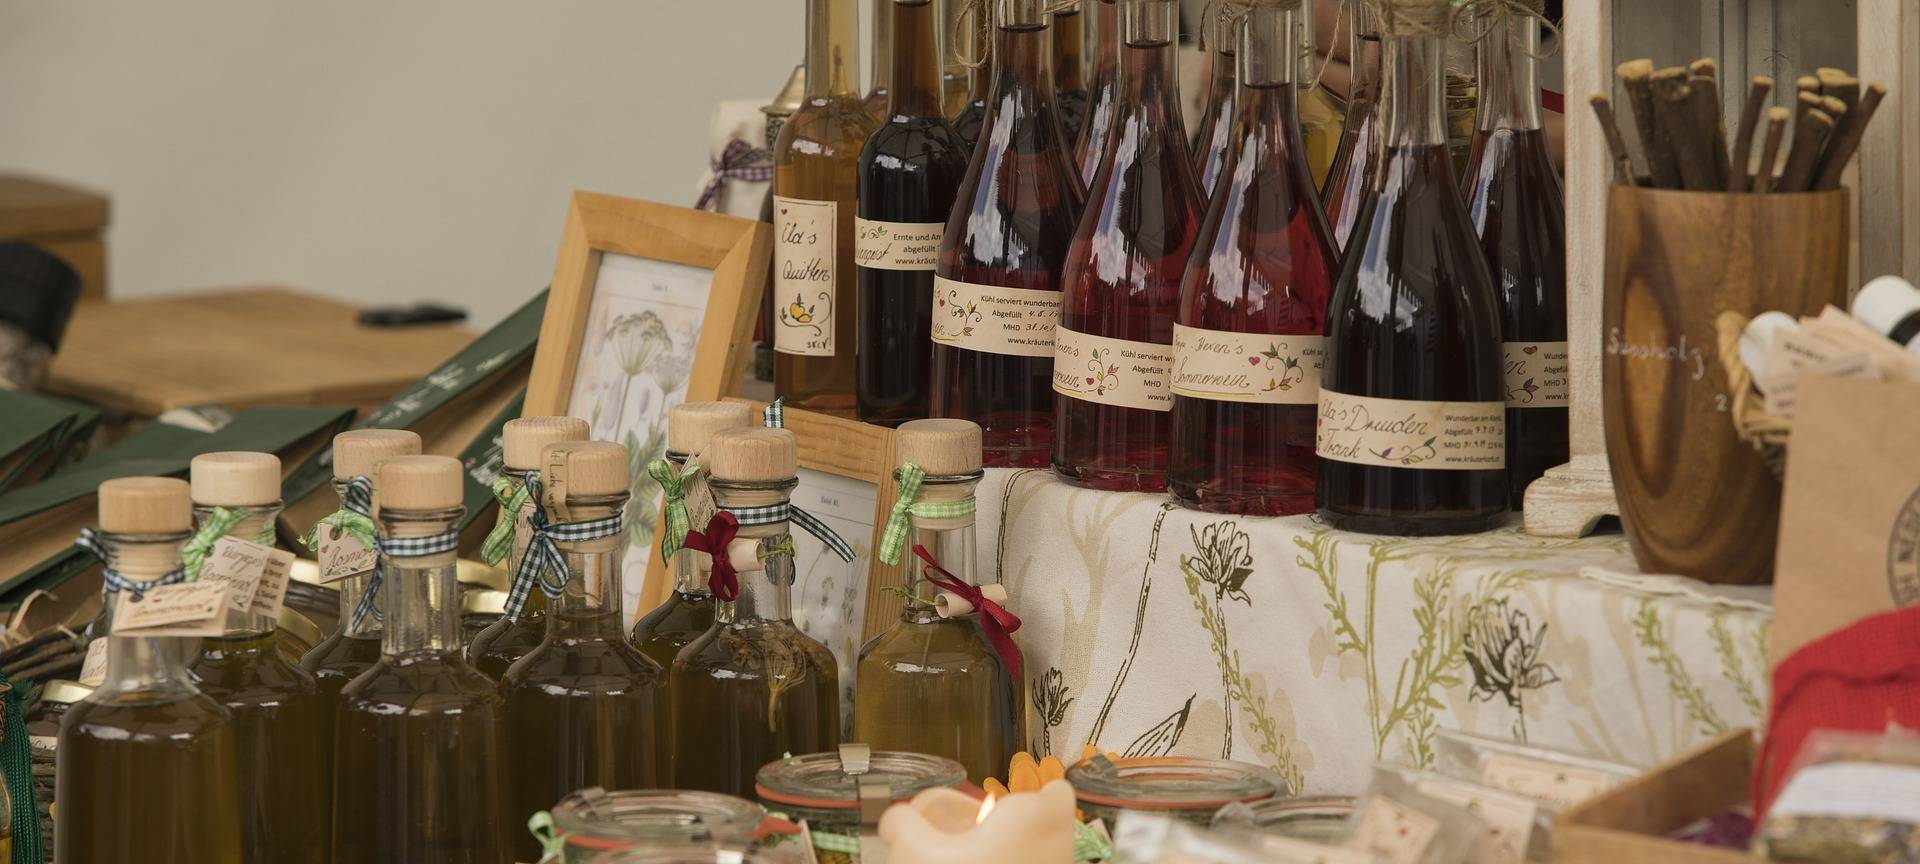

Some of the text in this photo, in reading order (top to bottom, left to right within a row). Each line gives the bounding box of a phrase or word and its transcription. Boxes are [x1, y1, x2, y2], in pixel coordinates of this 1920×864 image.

[893, 233, 914, 241] Ernte
[915, 233, 928, 241] und
[903, 245, 936, 254] abgefüllt
[980, 295, 995, 304] Kühl
[996, 297, 1022, 306] serviert
[992, 309, 1022, 319] Abgefüllt
[1003, 323, 1021, 331] MHD
[1121, 349, 1136, 359] Kühl
[1137, 352, 1163, 362] serviert
[1132, 365, 1164, 375] Abgefüllt
[1143, 379, 1161, 388] MHD
